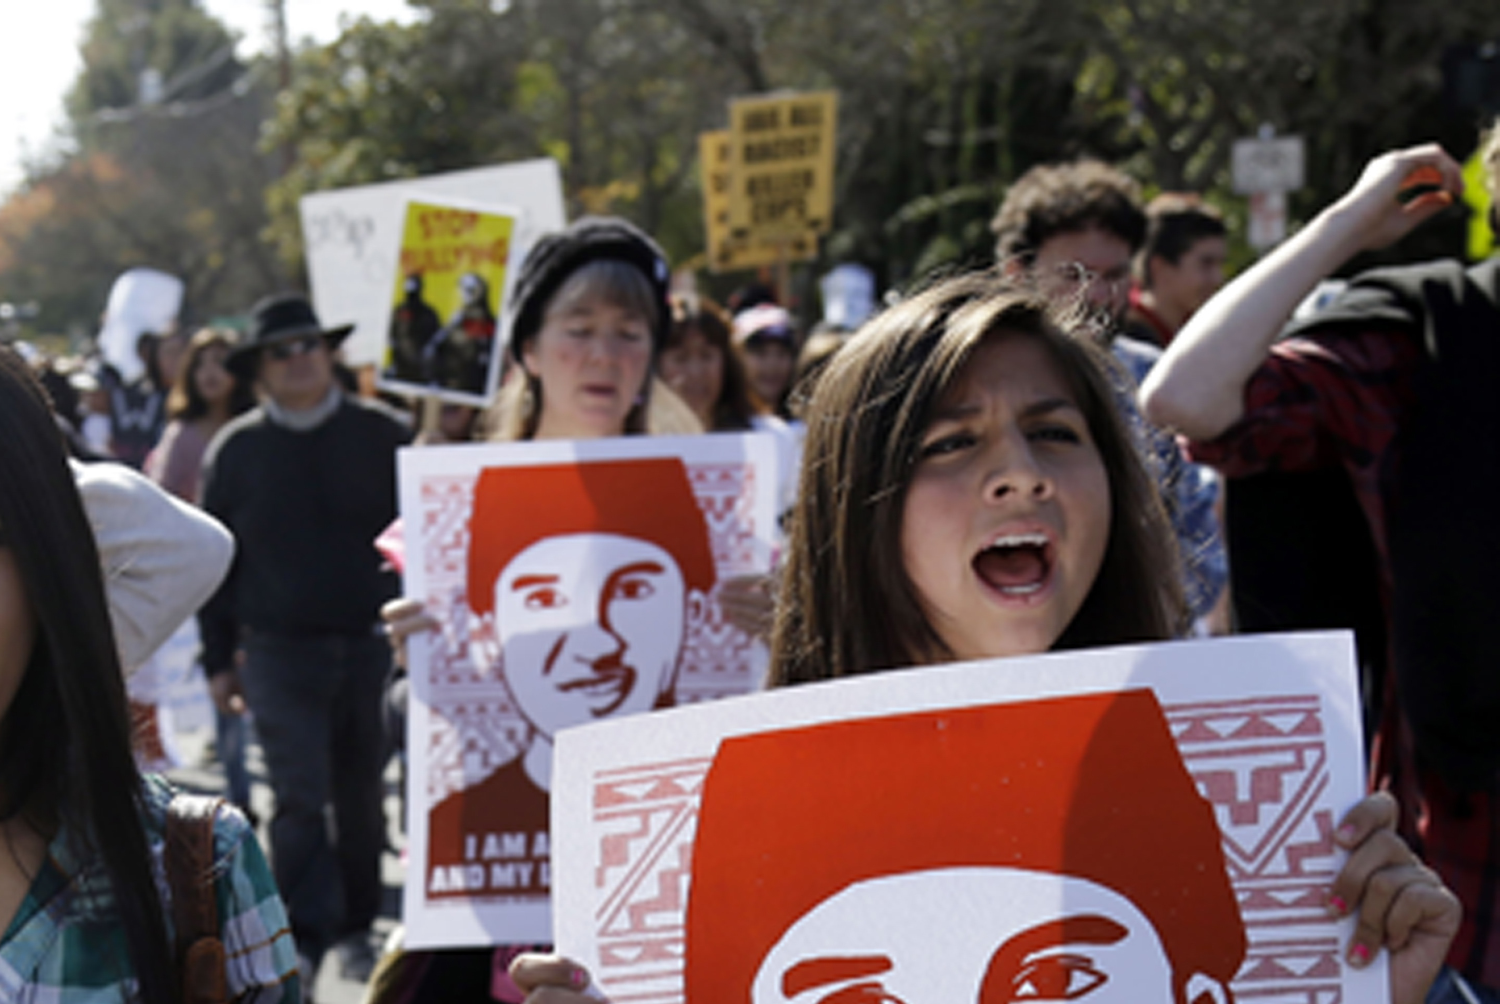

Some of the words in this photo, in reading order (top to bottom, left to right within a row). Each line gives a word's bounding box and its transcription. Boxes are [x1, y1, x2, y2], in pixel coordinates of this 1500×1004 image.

[465, 834, 476, 860] I
[482, 832, 526, 858] AM
[429, 863, 485, 892] AND
[490, 861, 533, 888] MY
